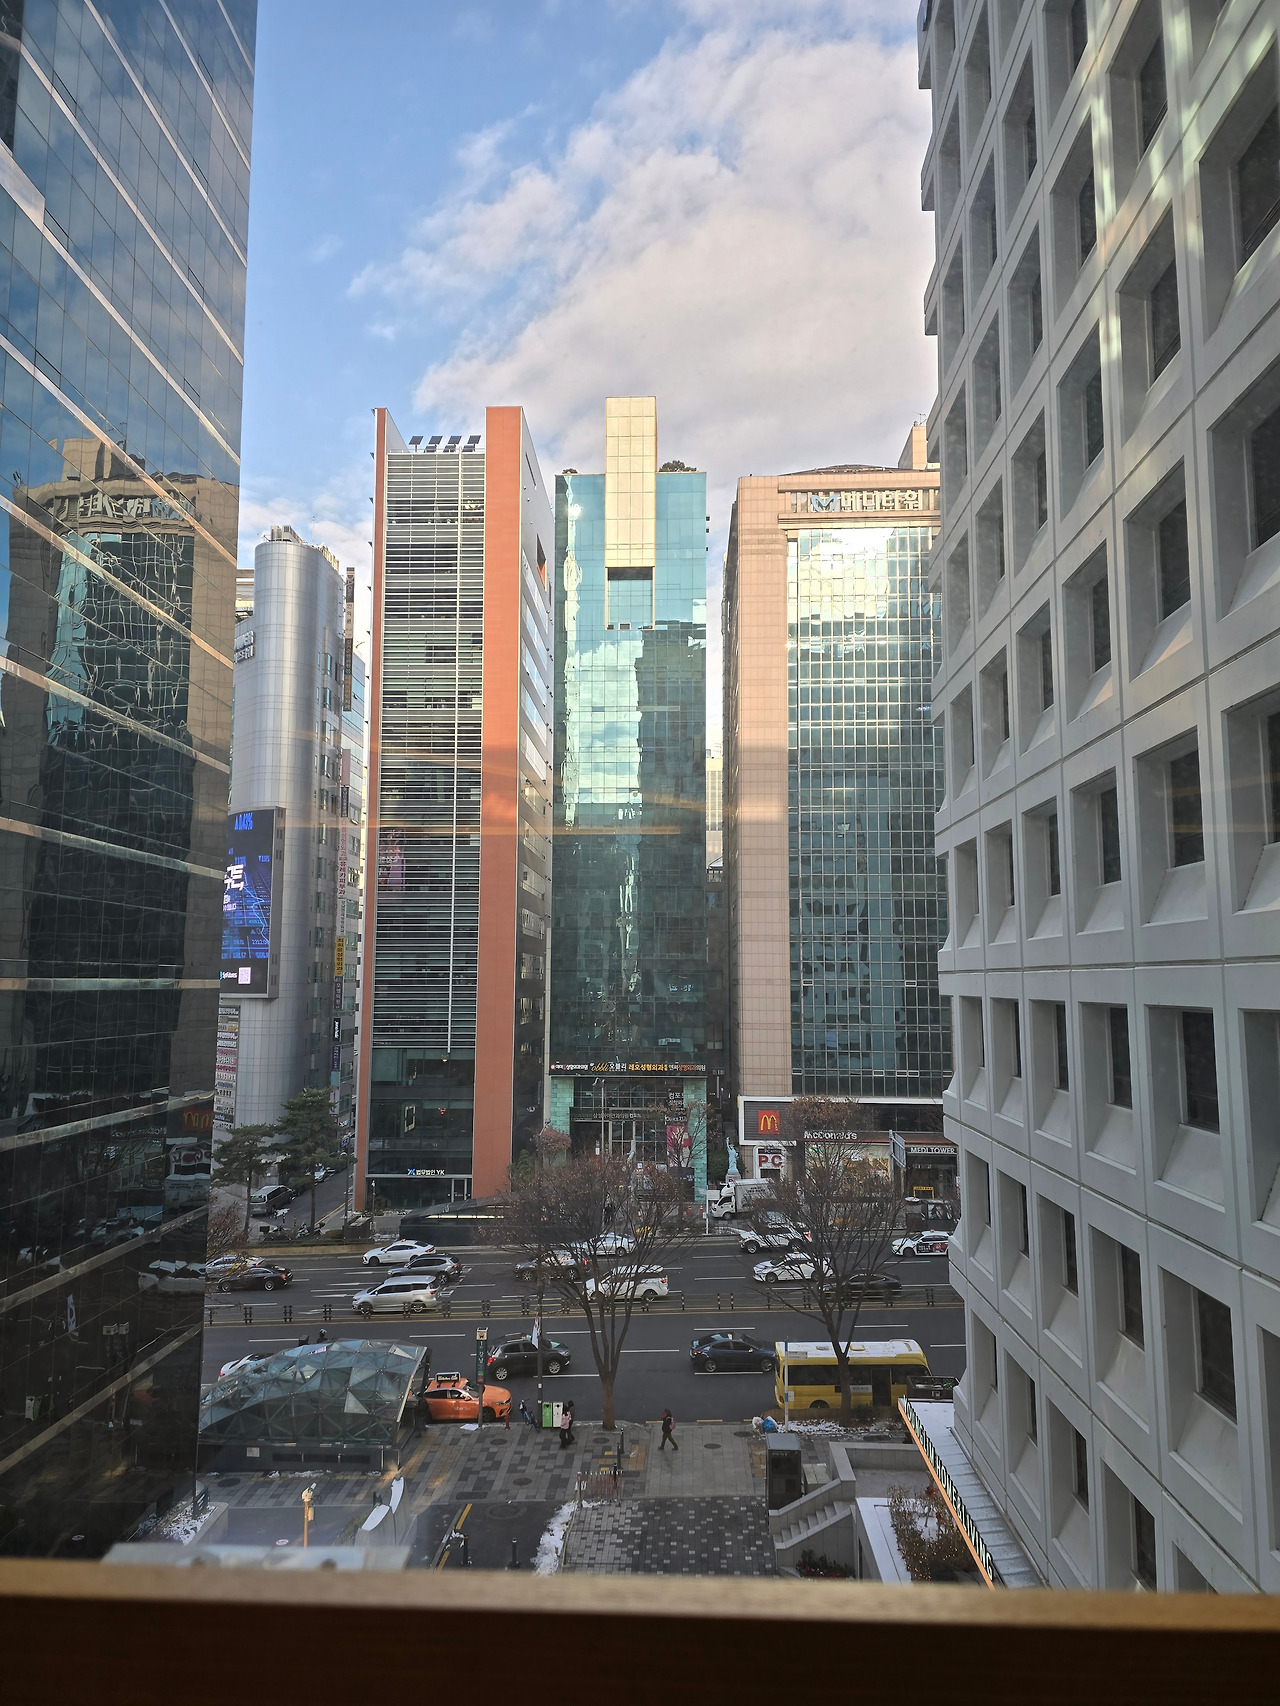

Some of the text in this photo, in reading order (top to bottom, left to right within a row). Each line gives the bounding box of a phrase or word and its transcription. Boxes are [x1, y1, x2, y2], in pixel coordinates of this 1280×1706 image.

[840, 491, 923, 511] 메디타워
[803, 1130, 858, 1140] McDonald's
[758, 1154, 783, 1168] PC
[935, 1455, 993, 1582] HOME&LIVING
